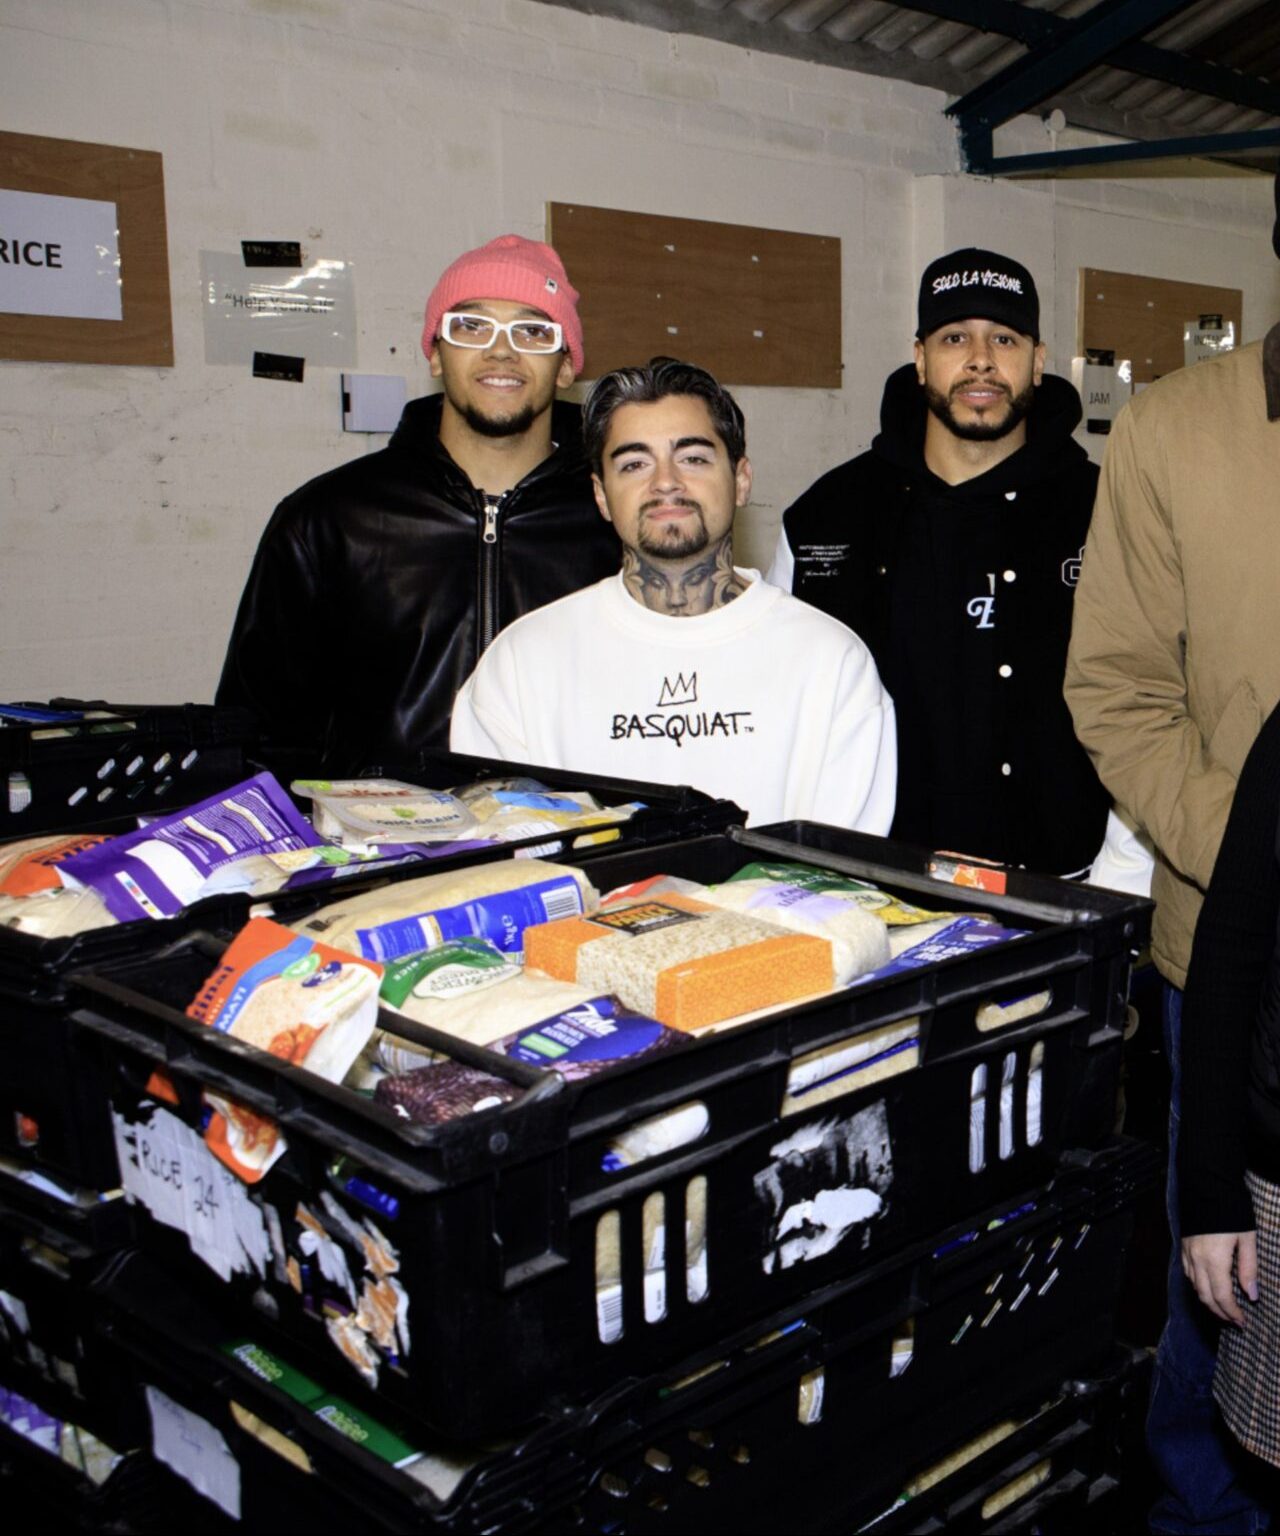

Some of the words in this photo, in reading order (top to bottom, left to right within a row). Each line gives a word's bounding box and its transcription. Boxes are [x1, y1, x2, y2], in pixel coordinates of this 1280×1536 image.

[932, 272, 960, 295] SOLO
[962, 270, 980, 286] LA
[980, 269, 1024, 295] VISIONE
[1089, 392, 1111, 405] JAM
[610, 711, 752, 748] BASQUIAT
